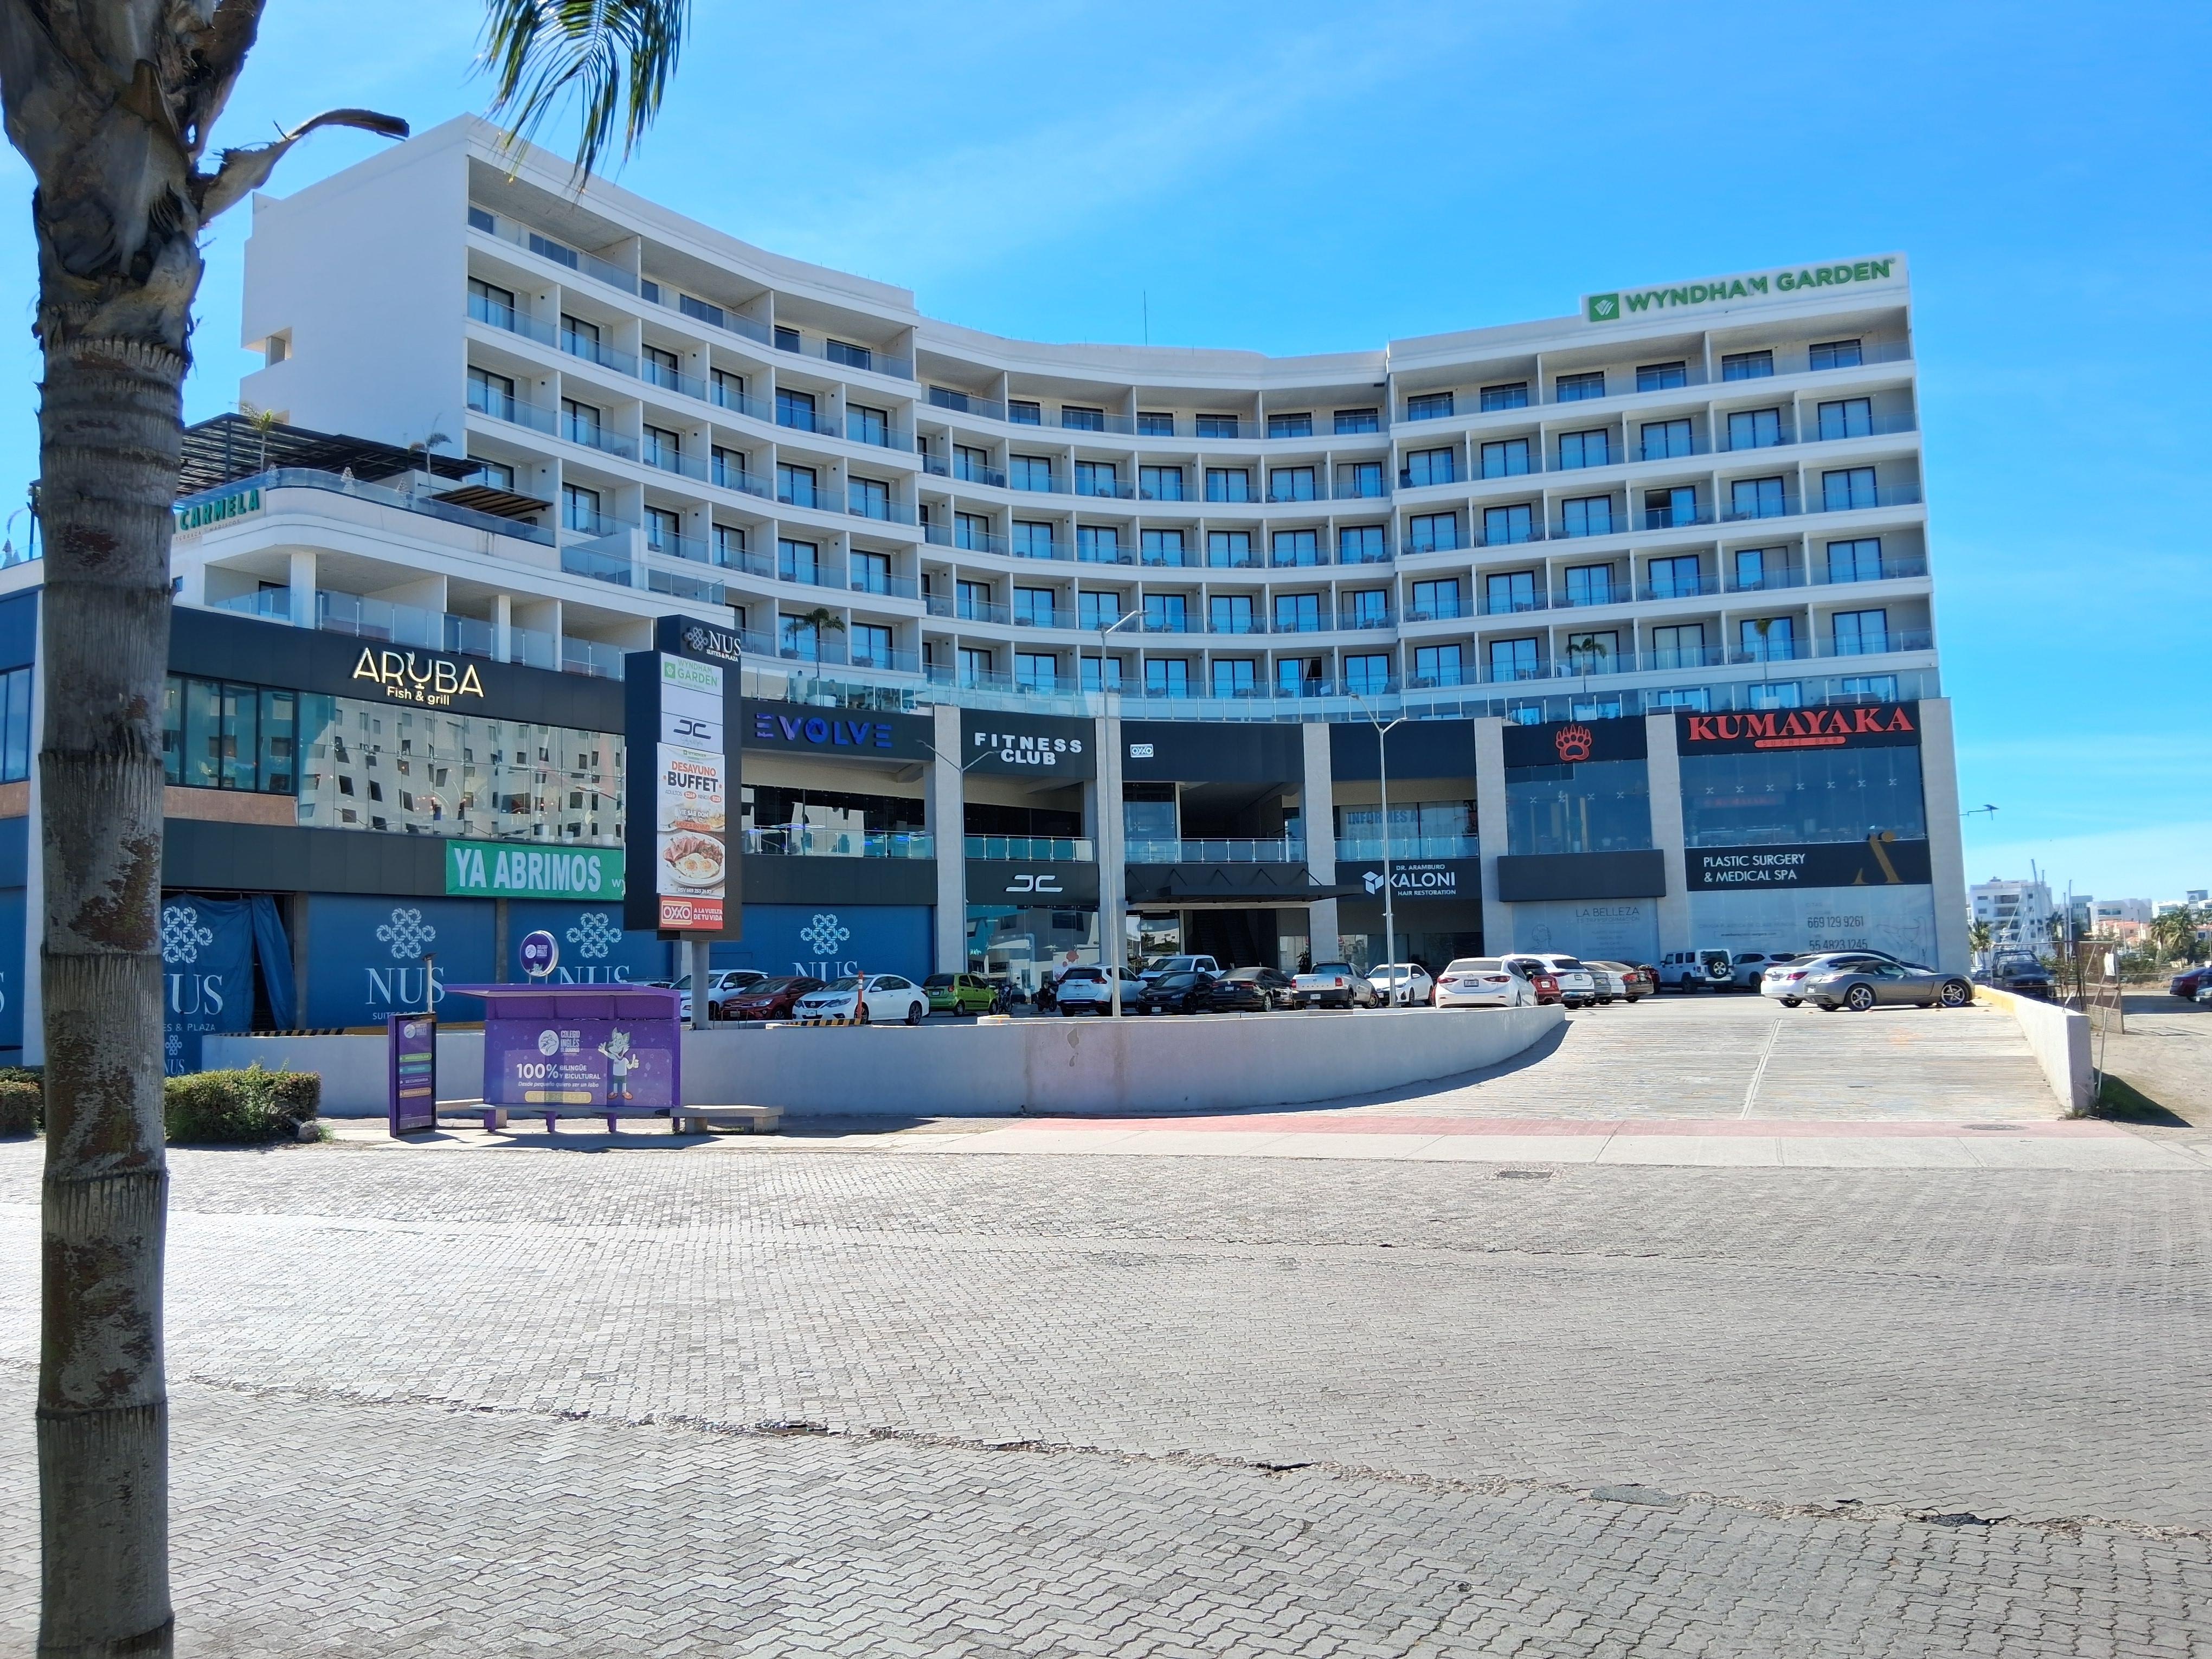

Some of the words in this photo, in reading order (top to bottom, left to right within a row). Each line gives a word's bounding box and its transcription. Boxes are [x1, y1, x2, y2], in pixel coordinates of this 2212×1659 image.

[1626, 275, 1769, 312] WYNDHAM
[1777, 259, 1892, 292] GARDEN
[180, 489, 260, 531] CARMELA
[209, 519, 240, 532] MARISCOS
[708, 630, 741, 656] NUS
[352, 647, 484, 698] ARUBA
[678, 658, 712, 674] WYNDHAM
[678, 668, 718, 687] GARDEN
[387, 686, 412, 700] Fish
[415, 691, 424, 702] &
[427, 694, 451, 706] grill
[755, 712, 893, 748] EVOLVE
[1687, 706, 1914, 741] KUMAYAKA
[974, 732, 1082, 754] FITNESS
[1763, 738, 1803, 747] SUSHI
[1815, 736, 1839, 745] BAR
[1000, 749, 1057, 765] CLUB
[1131, 747, 1153, 755] OXXO
[672, 761, 717, 777] DESAYUNO
[667, 770, 719, 793] BUFFET
[1703, 855, 1750, 868] PLASTIC
[1752, 853, 1806, 866] SURGERY
[454, 848, 487, 888] YA
[493, 851, 602, 892] ABRIMOS
[1703, 872, 1713, 883] &
[1715, 870, 1771, 882] MEDICAL
[1774, 869, 1797, 880] SPA
[1390, 871, 1456, 888] KALONI
[663, 906, 691, 919] OXXO
[1576, 909, 1590, 917] LA
[1593, 906, 1640, 917] BELLEZA
[1807, 917, 1825, 929] 669
[1827, 916, 1842, 928] 129
[1843, 916, 1864, 928] 9261
[1809, 940, 1821, 951] 55
[1823, 940, 1846, 950] 4823
[1847, 938, 1868, 949] 1245
[364, 967, 445, 1004] NUS
[163, 974, 223, 1015] US
[176, 1023, 183, 1032] &
[187, 1023, 216, 1032] PLAZA
[561, 1030, 580, 1038] COLEGIO
[516, 1063, 559, 1079] 100%
